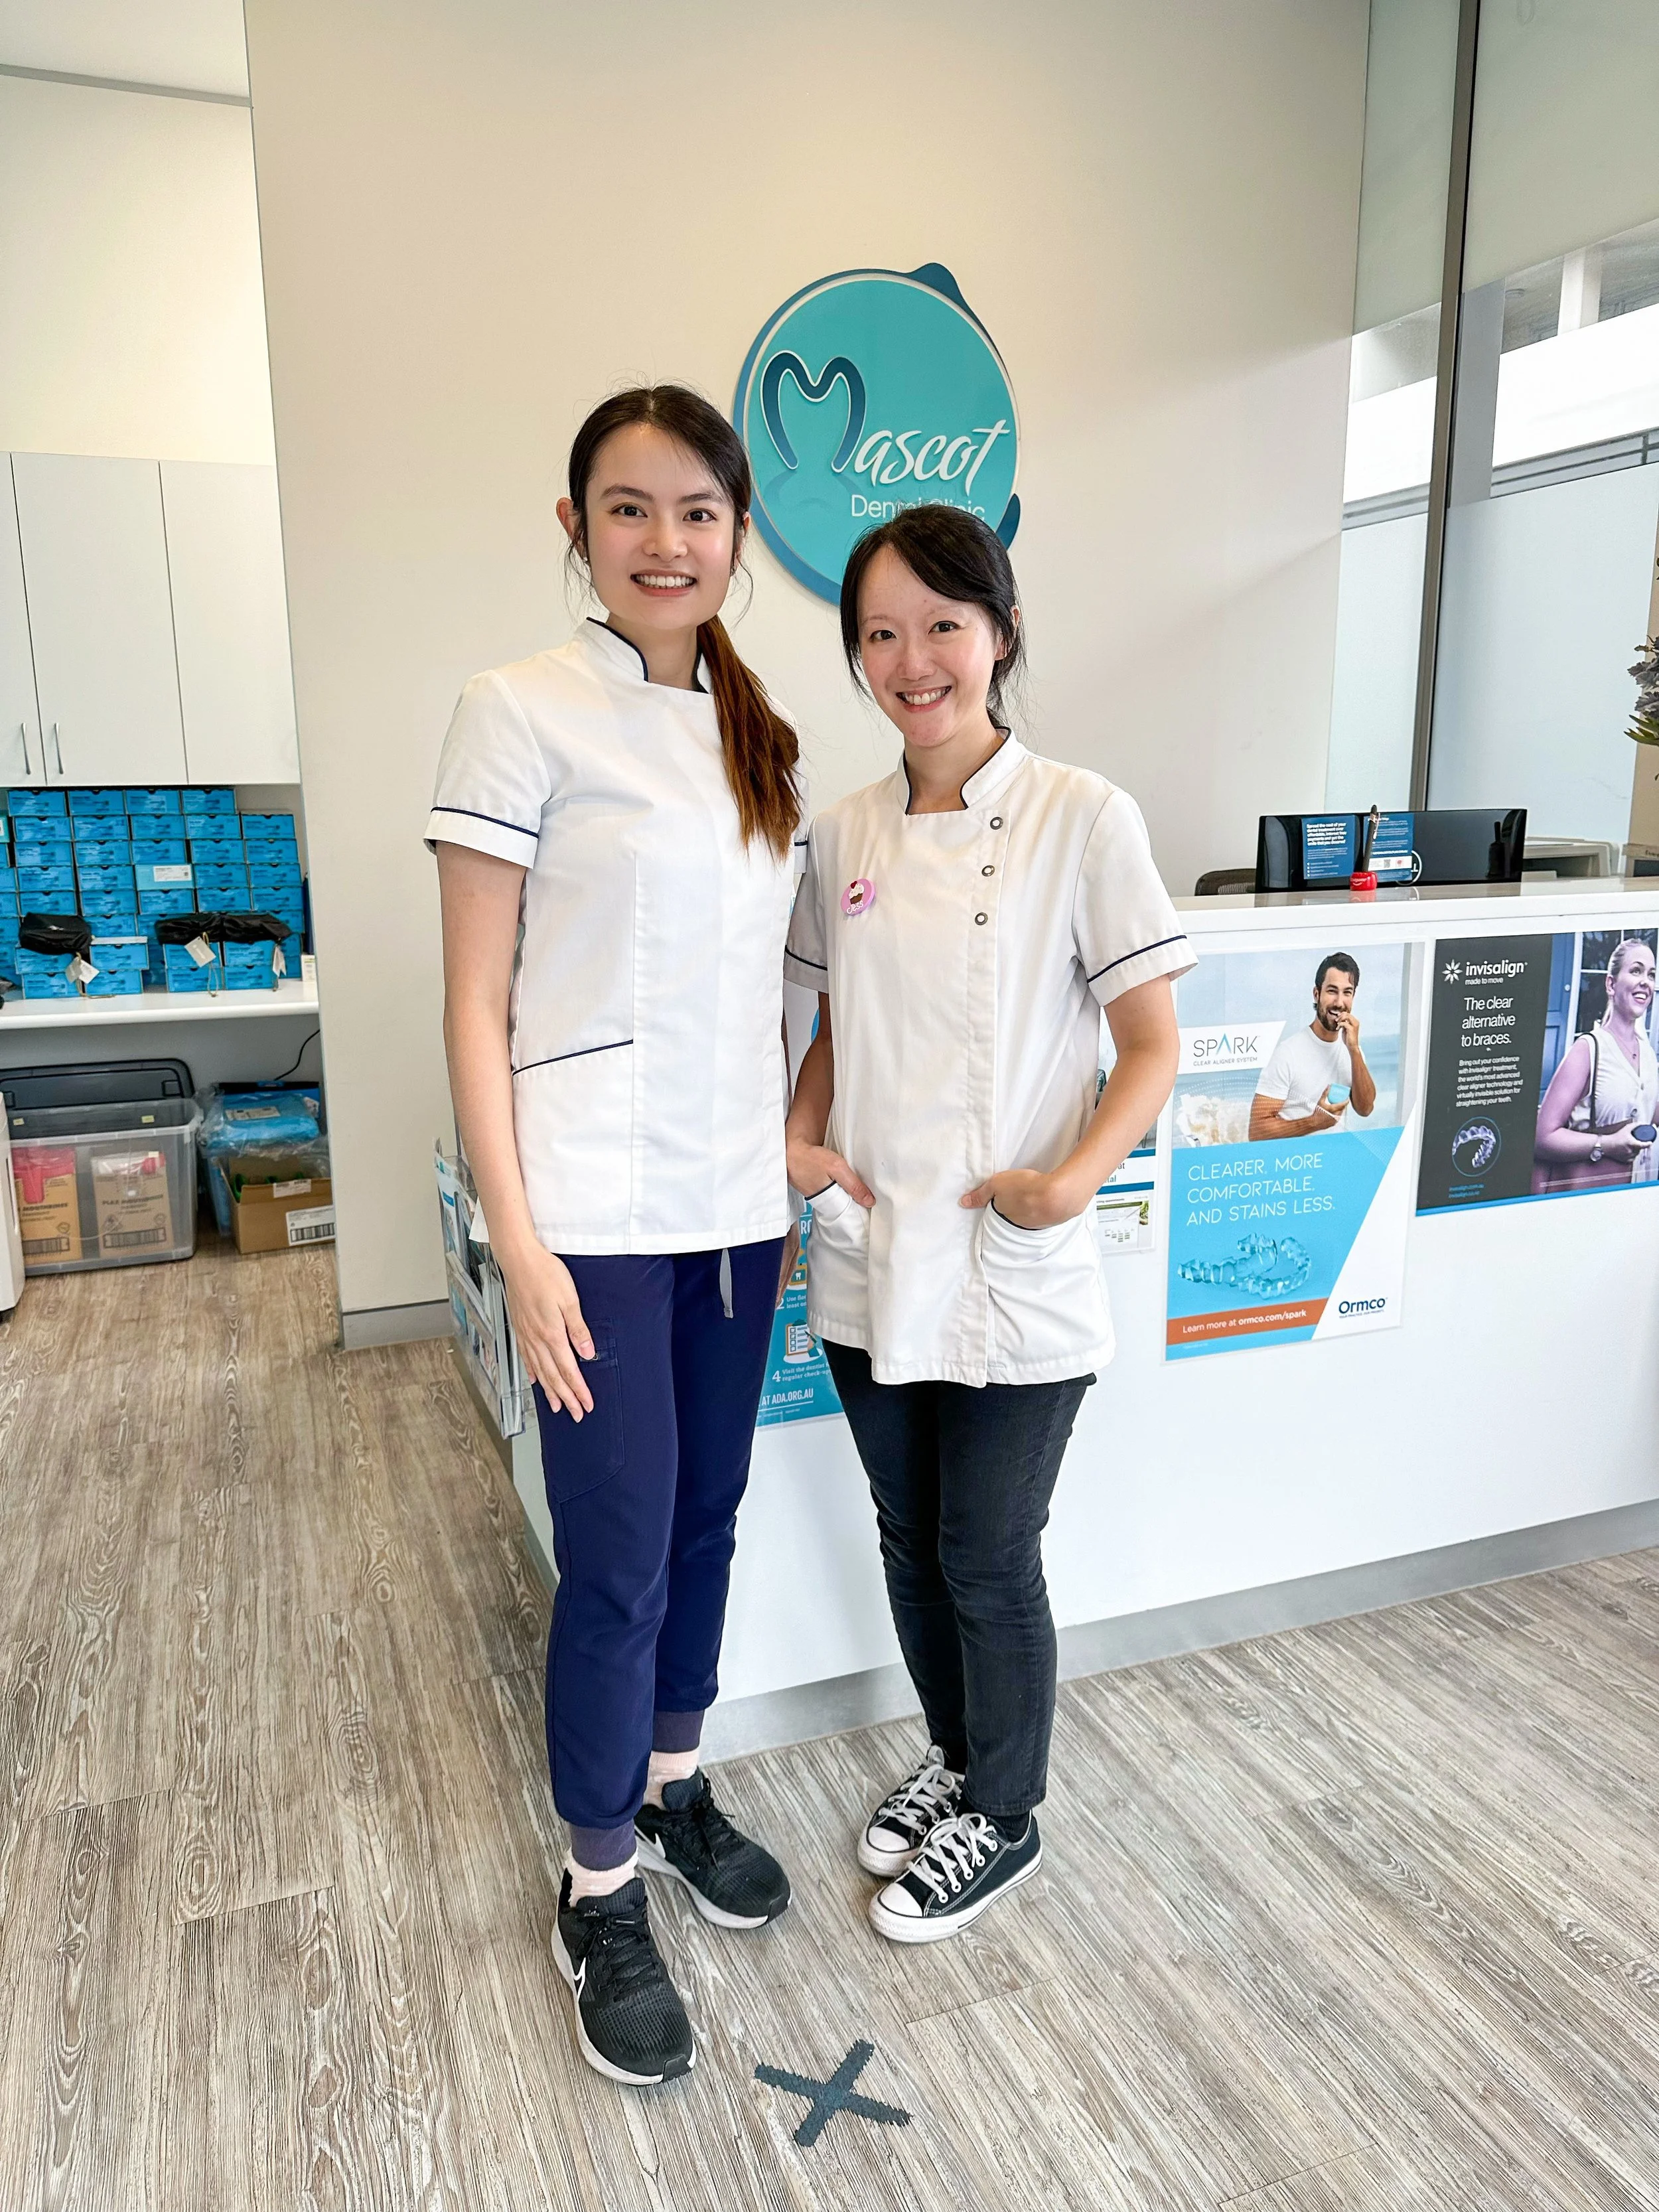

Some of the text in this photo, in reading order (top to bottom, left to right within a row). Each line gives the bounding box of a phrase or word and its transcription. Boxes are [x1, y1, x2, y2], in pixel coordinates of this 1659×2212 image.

[760, 349, 1011, 497] Mascot
[1465, 959, 1525, 978] invisalign
[1464, 995, 1514, 1011] The clear
[1462, 1013, 1516, 1029] alternative
[1193, 1033, 1258, 1057] SPARK
[1461, 1033, 1512, 1047] to braces.
[1188, 1152, 1324, 1181] CLEARER. MORE
[1187, 1176, 1316, 1204] COMFORTABLE.
[1187, 1195, 1336, 1226] AND STAINS LESS.
[1338, 1297, 1386, 1314] Ormco
[1183, 1309, 1307, 1334] Learn more at ormco.com/spark
[772, 1370, 782, 1382] 4
[761, 1388, 814, 1406] AT ADA.ORG.AU
